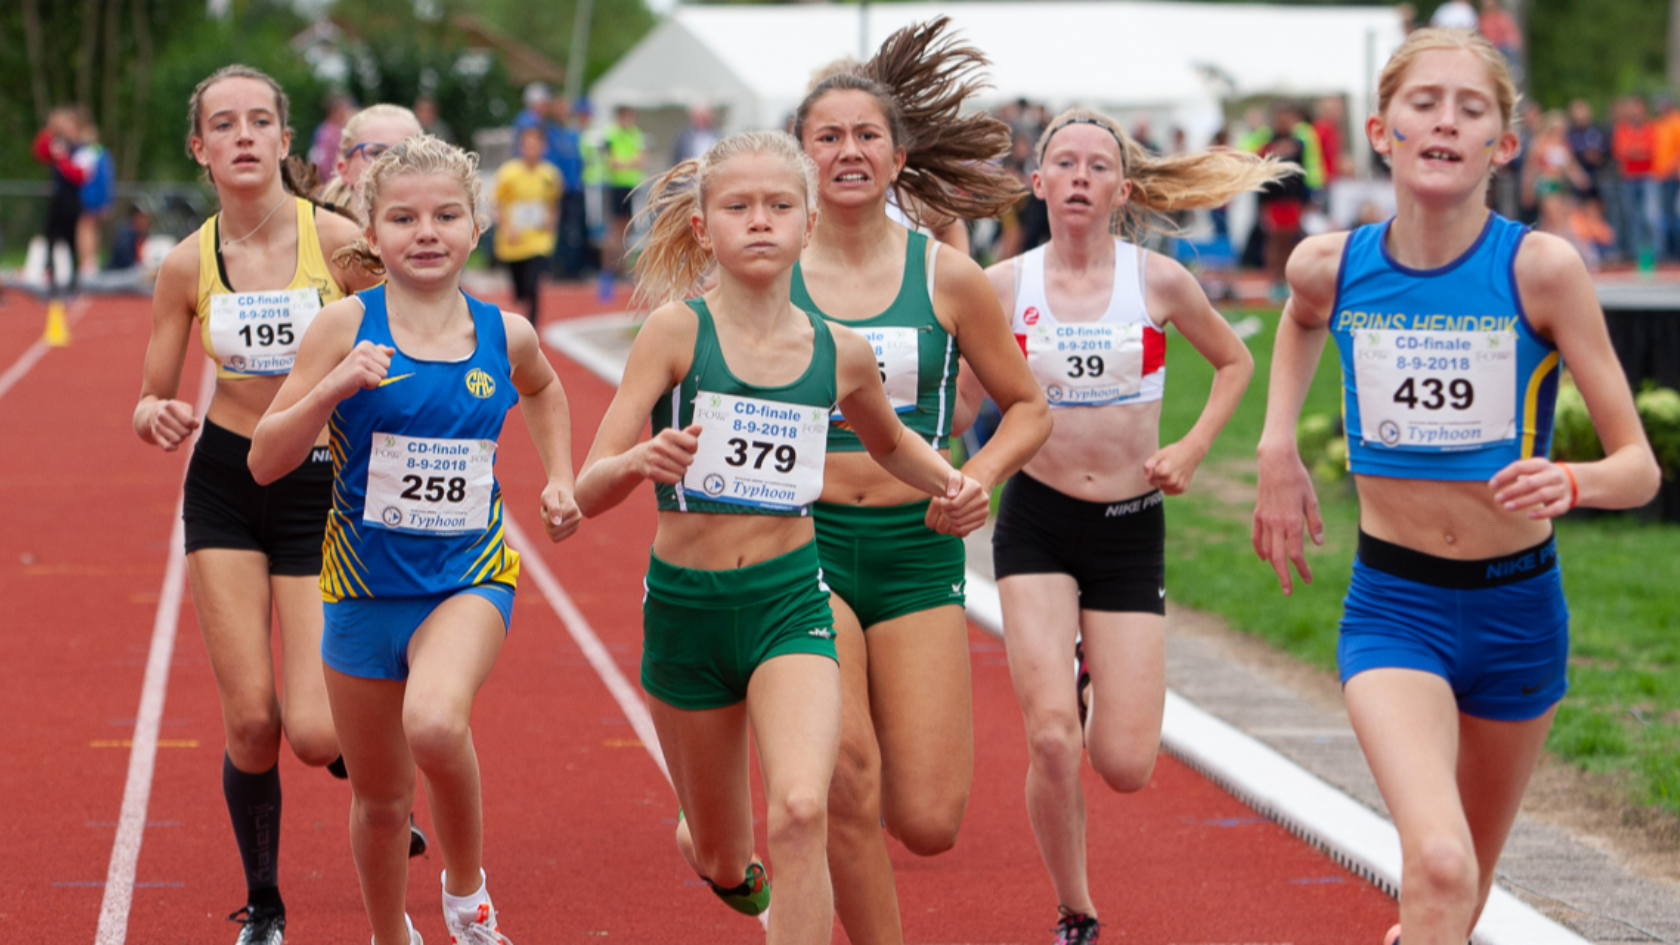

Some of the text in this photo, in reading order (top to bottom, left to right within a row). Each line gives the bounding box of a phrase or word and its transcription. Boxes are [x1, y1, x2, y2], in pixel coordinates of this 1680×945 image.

[238, 295, 290, 306] CD-finale
[239, 308, 290, 320] 8-9-2018
[1056, 327, 1112, 337] CD-finale
[1337, 310, 1520, 339] PRINS HENDRIK
[238, 322, 295, 347] 195
[1058, 340, 1111, 351] 8-9-2018
[1395, 336, 1471, 351] CD-finale
[250, 356, 297, 369] Typhoo
[1066, 355, 1104, 378] 39
[1396, 356, 1470, 371] 8-9-2018
[1068, 387, 1120, 400] Typhoon
[1393, 377, 1474, 411] 439
[734, 401, 801, 422] CD-finale
[733, 419, 797, 439] 8-9-2018
[1407, 426, 1482, 443] Typhoon
[312, 449, 333, 462] NI
[407, 441, 470, 455] CD-finale
[725, 437, 797, 474] 379
[406, 457, 467, 471] 8-9-2018
[400, 474, 466, 503] 258
[733, 480, 795, 501] Typhoon
[1104, 499, 1142, 518] NIKE
[409, 512, 466, 528] Typhoon
[1486, 552, 1537, 580] NIKE
